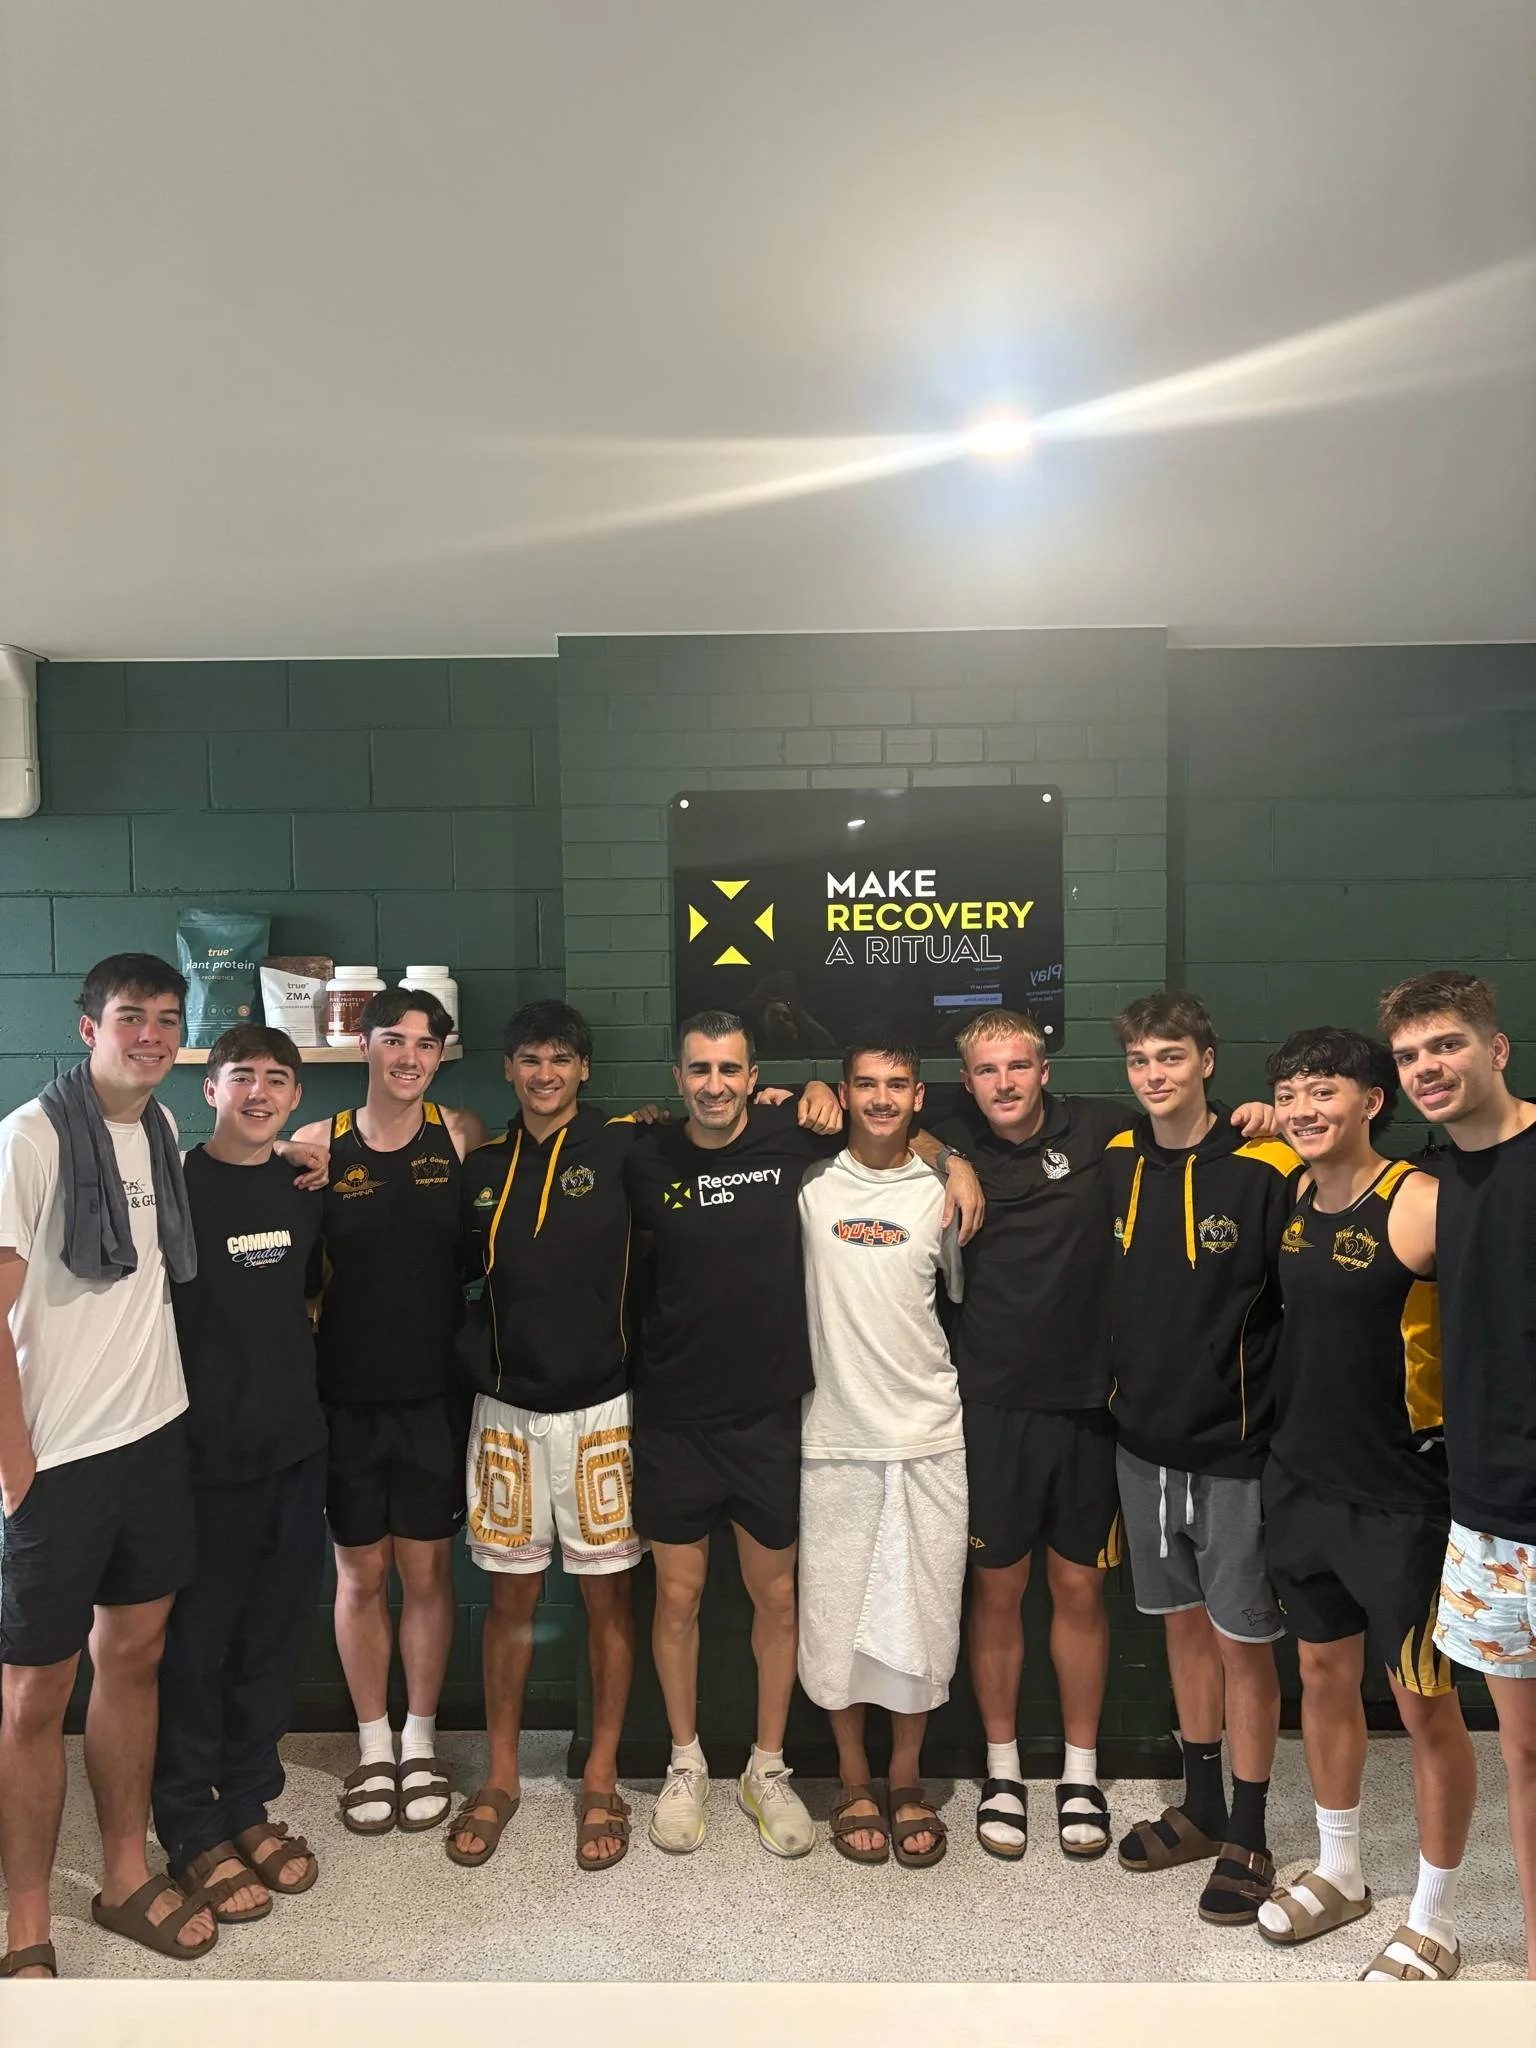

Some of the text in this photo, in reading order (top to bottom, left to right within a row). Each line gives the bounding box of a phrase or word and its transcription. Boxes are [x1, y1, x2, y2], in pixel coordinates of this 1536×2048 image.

[827, 869, 936, 899] MAKE
[827, 901, 1034, 932] RECOVERY
[825, 935, 1002, 964] A RITUAL
[212, 960, 255, 972] protein
[286, 992, 311, 1001] ZMA
[415, 1177, 449, 1185] THUNDER
[698, 1168, 781, 1191] Recovery
[131, 1196, 141, 1209] &
[699, 1187, 735, 1207] Lab
[837, 1219, 908, 1245] butter
[226, 1230, 292, 1255] COMMON
[231, 1247, 288, 1263] Sunday
[1332, 1253, 1370, 1269] THUNDER
